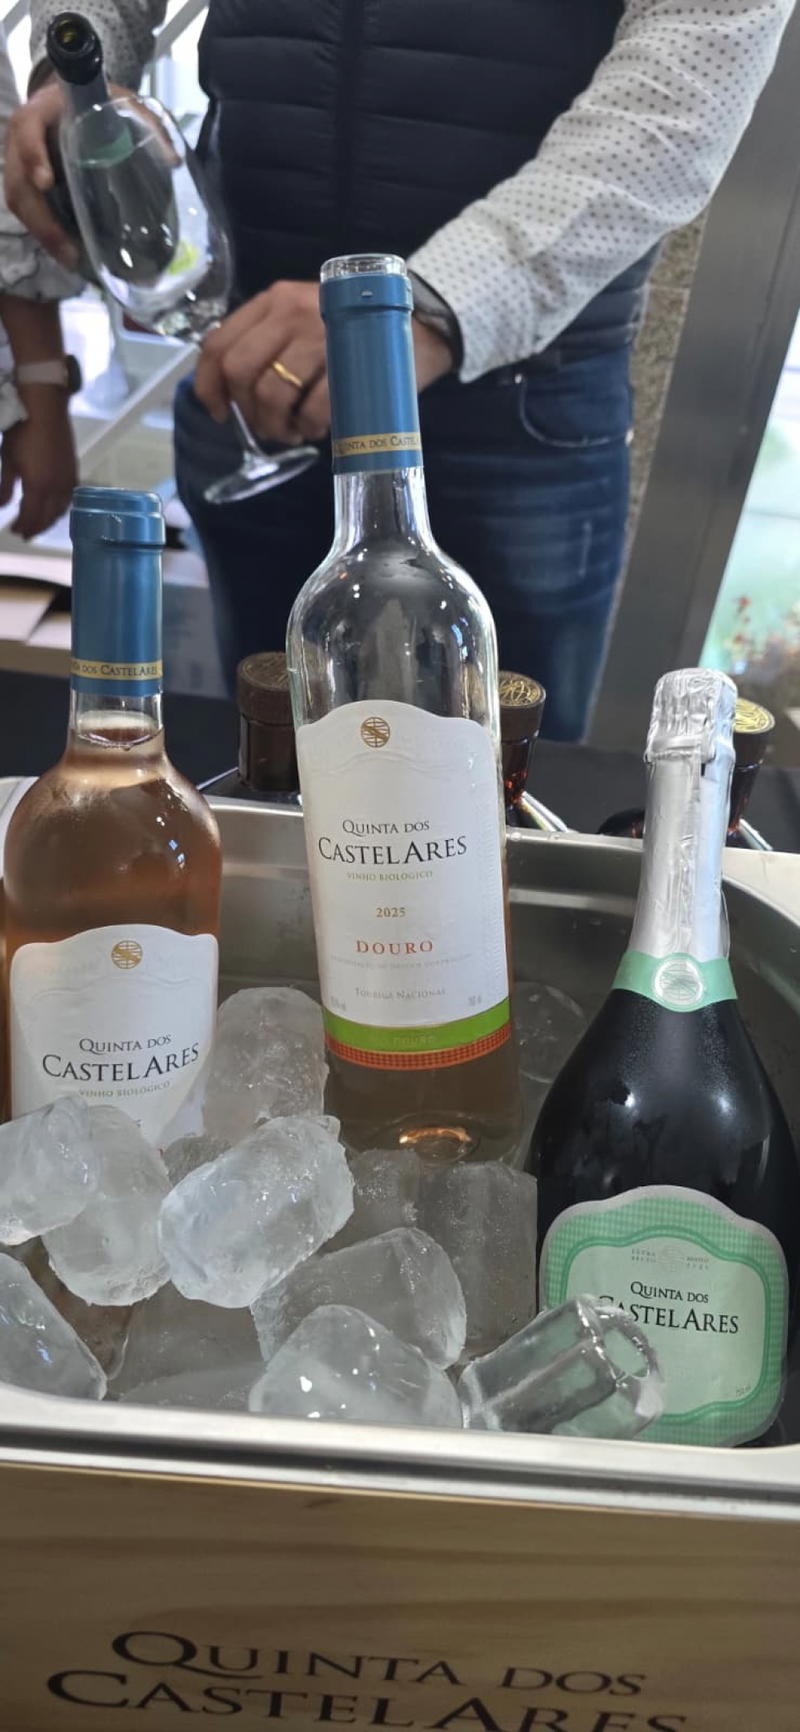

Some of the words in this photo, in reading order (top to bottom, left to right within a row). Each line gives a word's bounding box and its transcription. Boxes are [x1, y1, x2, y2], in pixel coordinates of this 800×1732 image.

[342, 819, 399, 837] QUINTA
[404, 821, 430, 833] DOS
[318, 836, 467, 865] CASTELARES
[376, 907, 406, 918] 2025
[356, 940, 433, 955] DOURO
[79, 1038, 142, 1055] QUINTA
[147, 1034, 172, 1049] DOS
[42, 1043, 199, 1082] CASTELARES
[630, 1281, 683, 1299] QUINTA
[687, 1292, 709, 1304] DOS
[599, 1295, 739, 1334] STELARES
[112, 1631, 466, 1686] QUINTA
[500, 1667, 647, 1696] DOS
